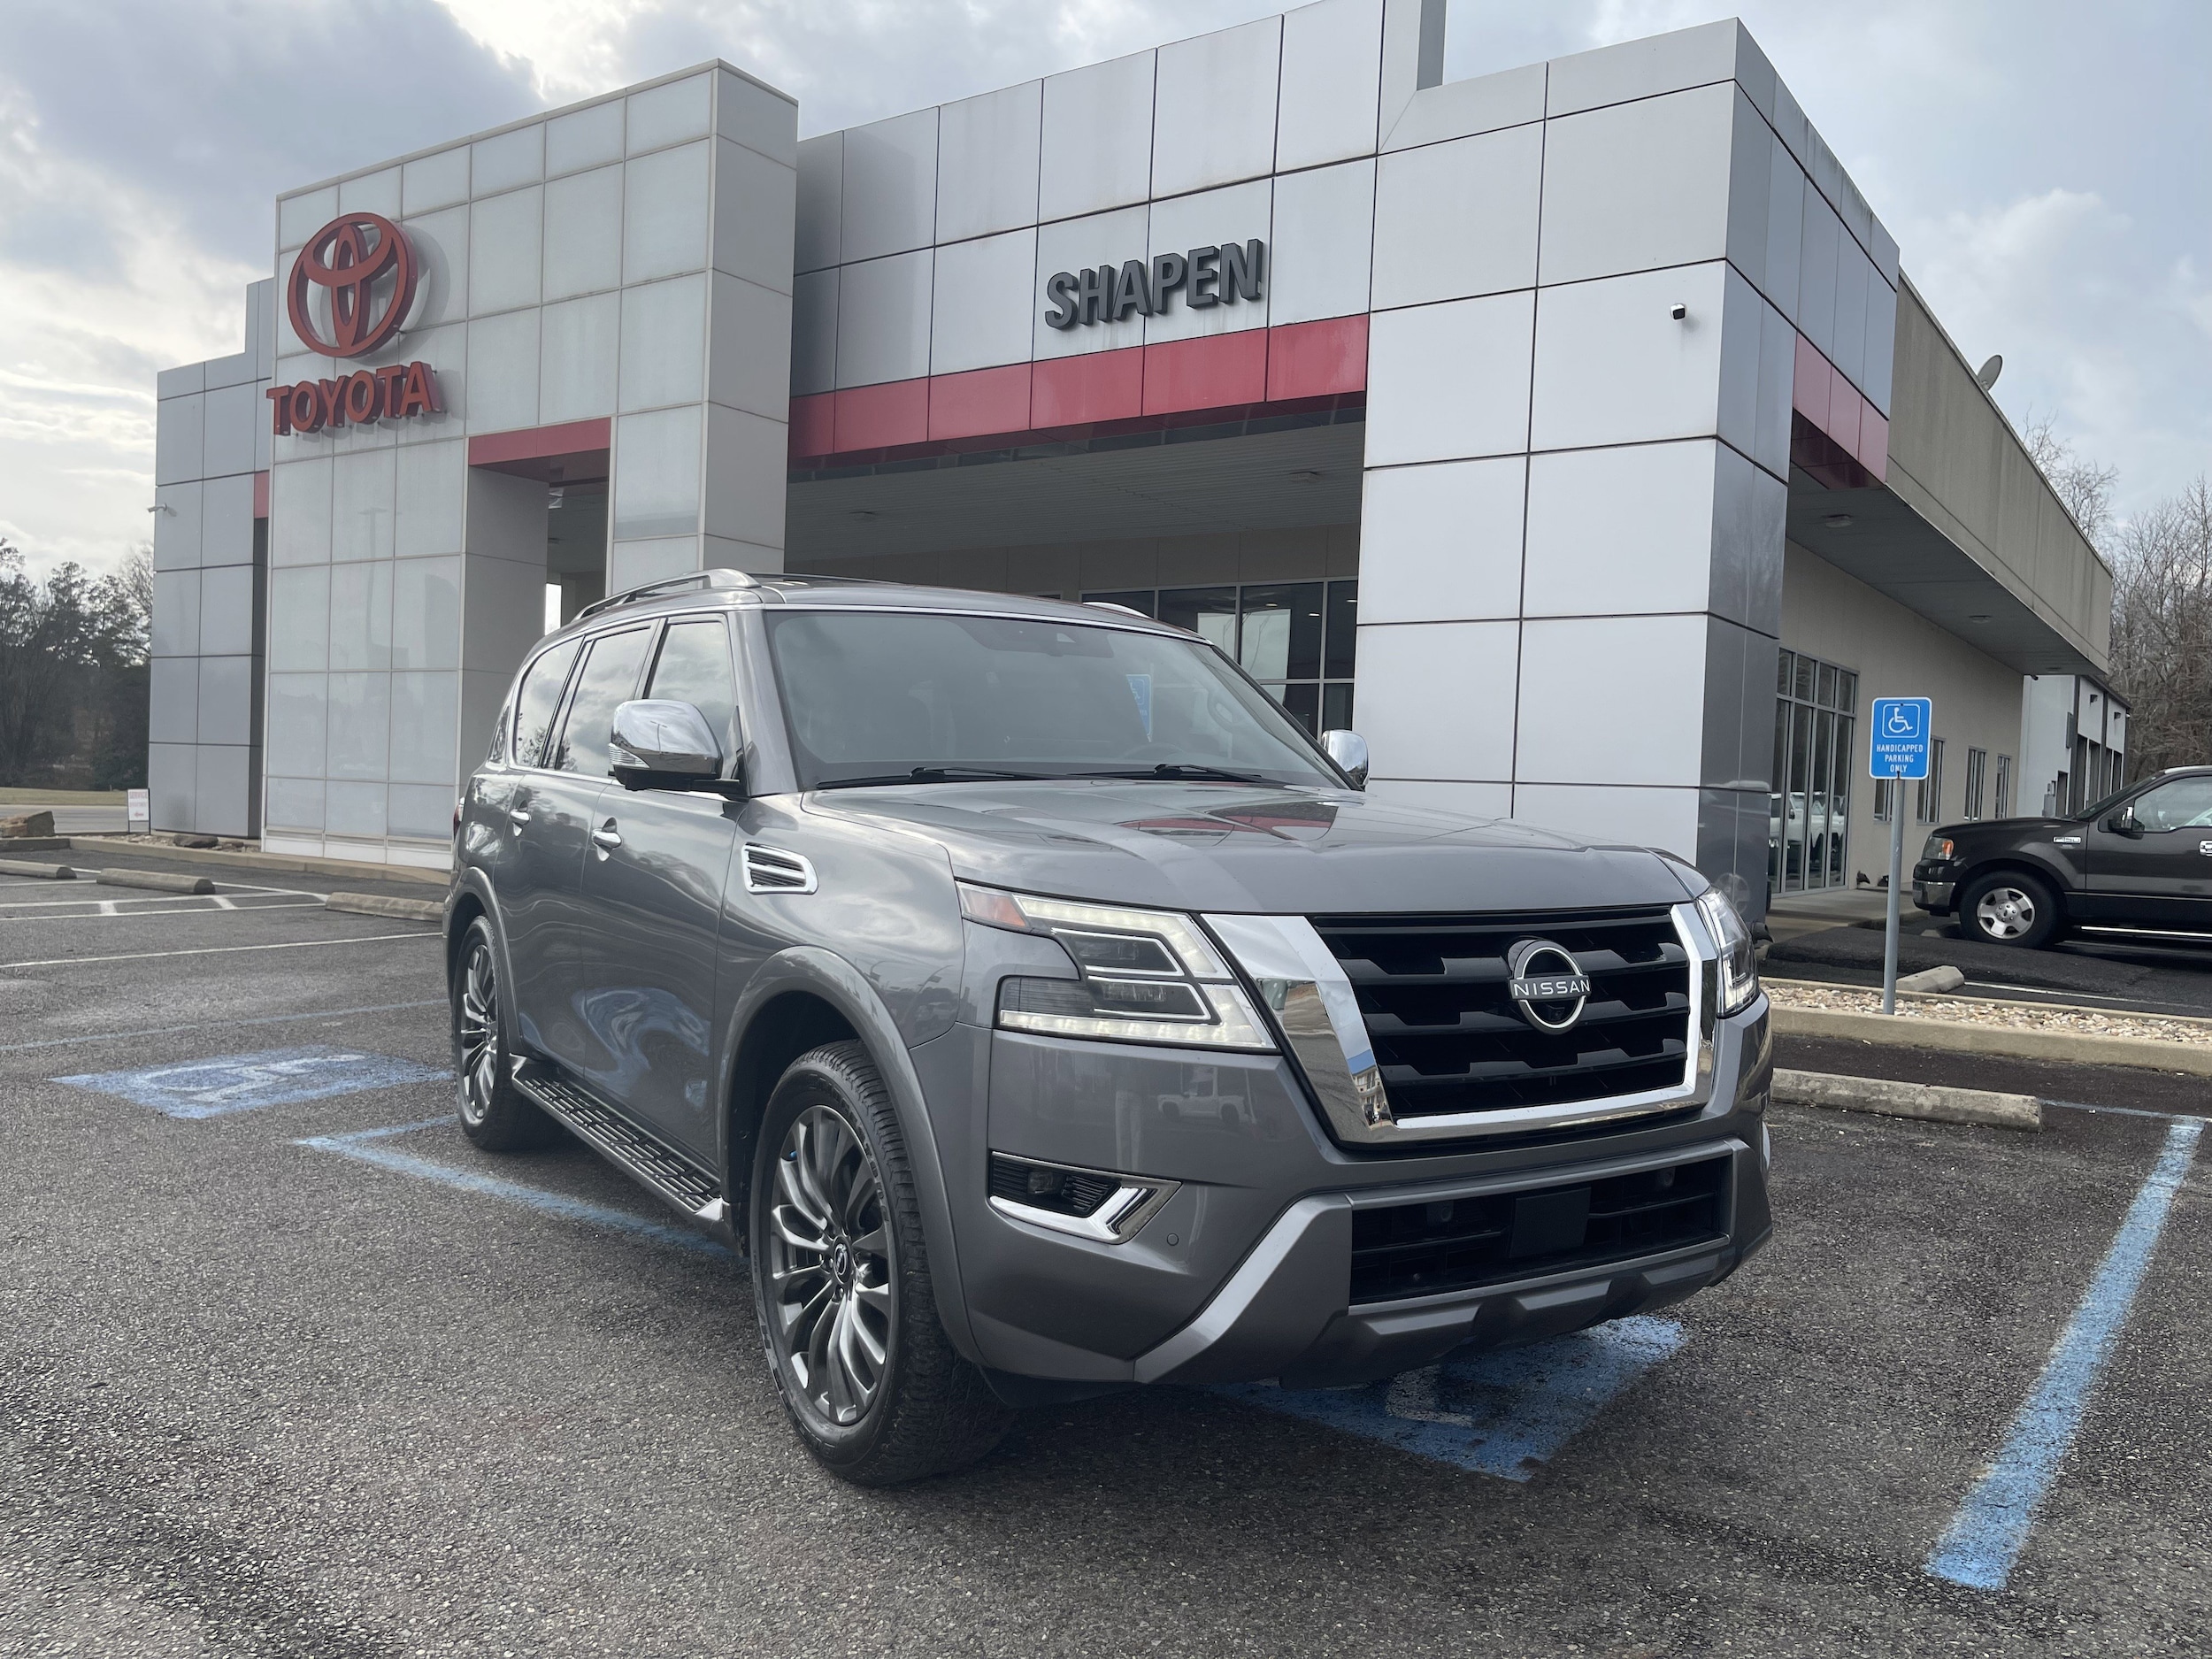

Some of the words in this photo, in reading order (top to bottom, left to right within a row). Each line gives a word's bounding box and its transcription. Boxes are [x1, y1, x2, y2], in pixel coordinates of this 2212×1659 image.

[1045, 238, 1263, 329] SHAPEN
[266, 361, 442, 435] TOYOTA
[1876, 744, 1924, 753] HANDICAPPED
[1885, 754, 1914, 763] PARKING
[1513, 979, 1590, 996] NISSAN
